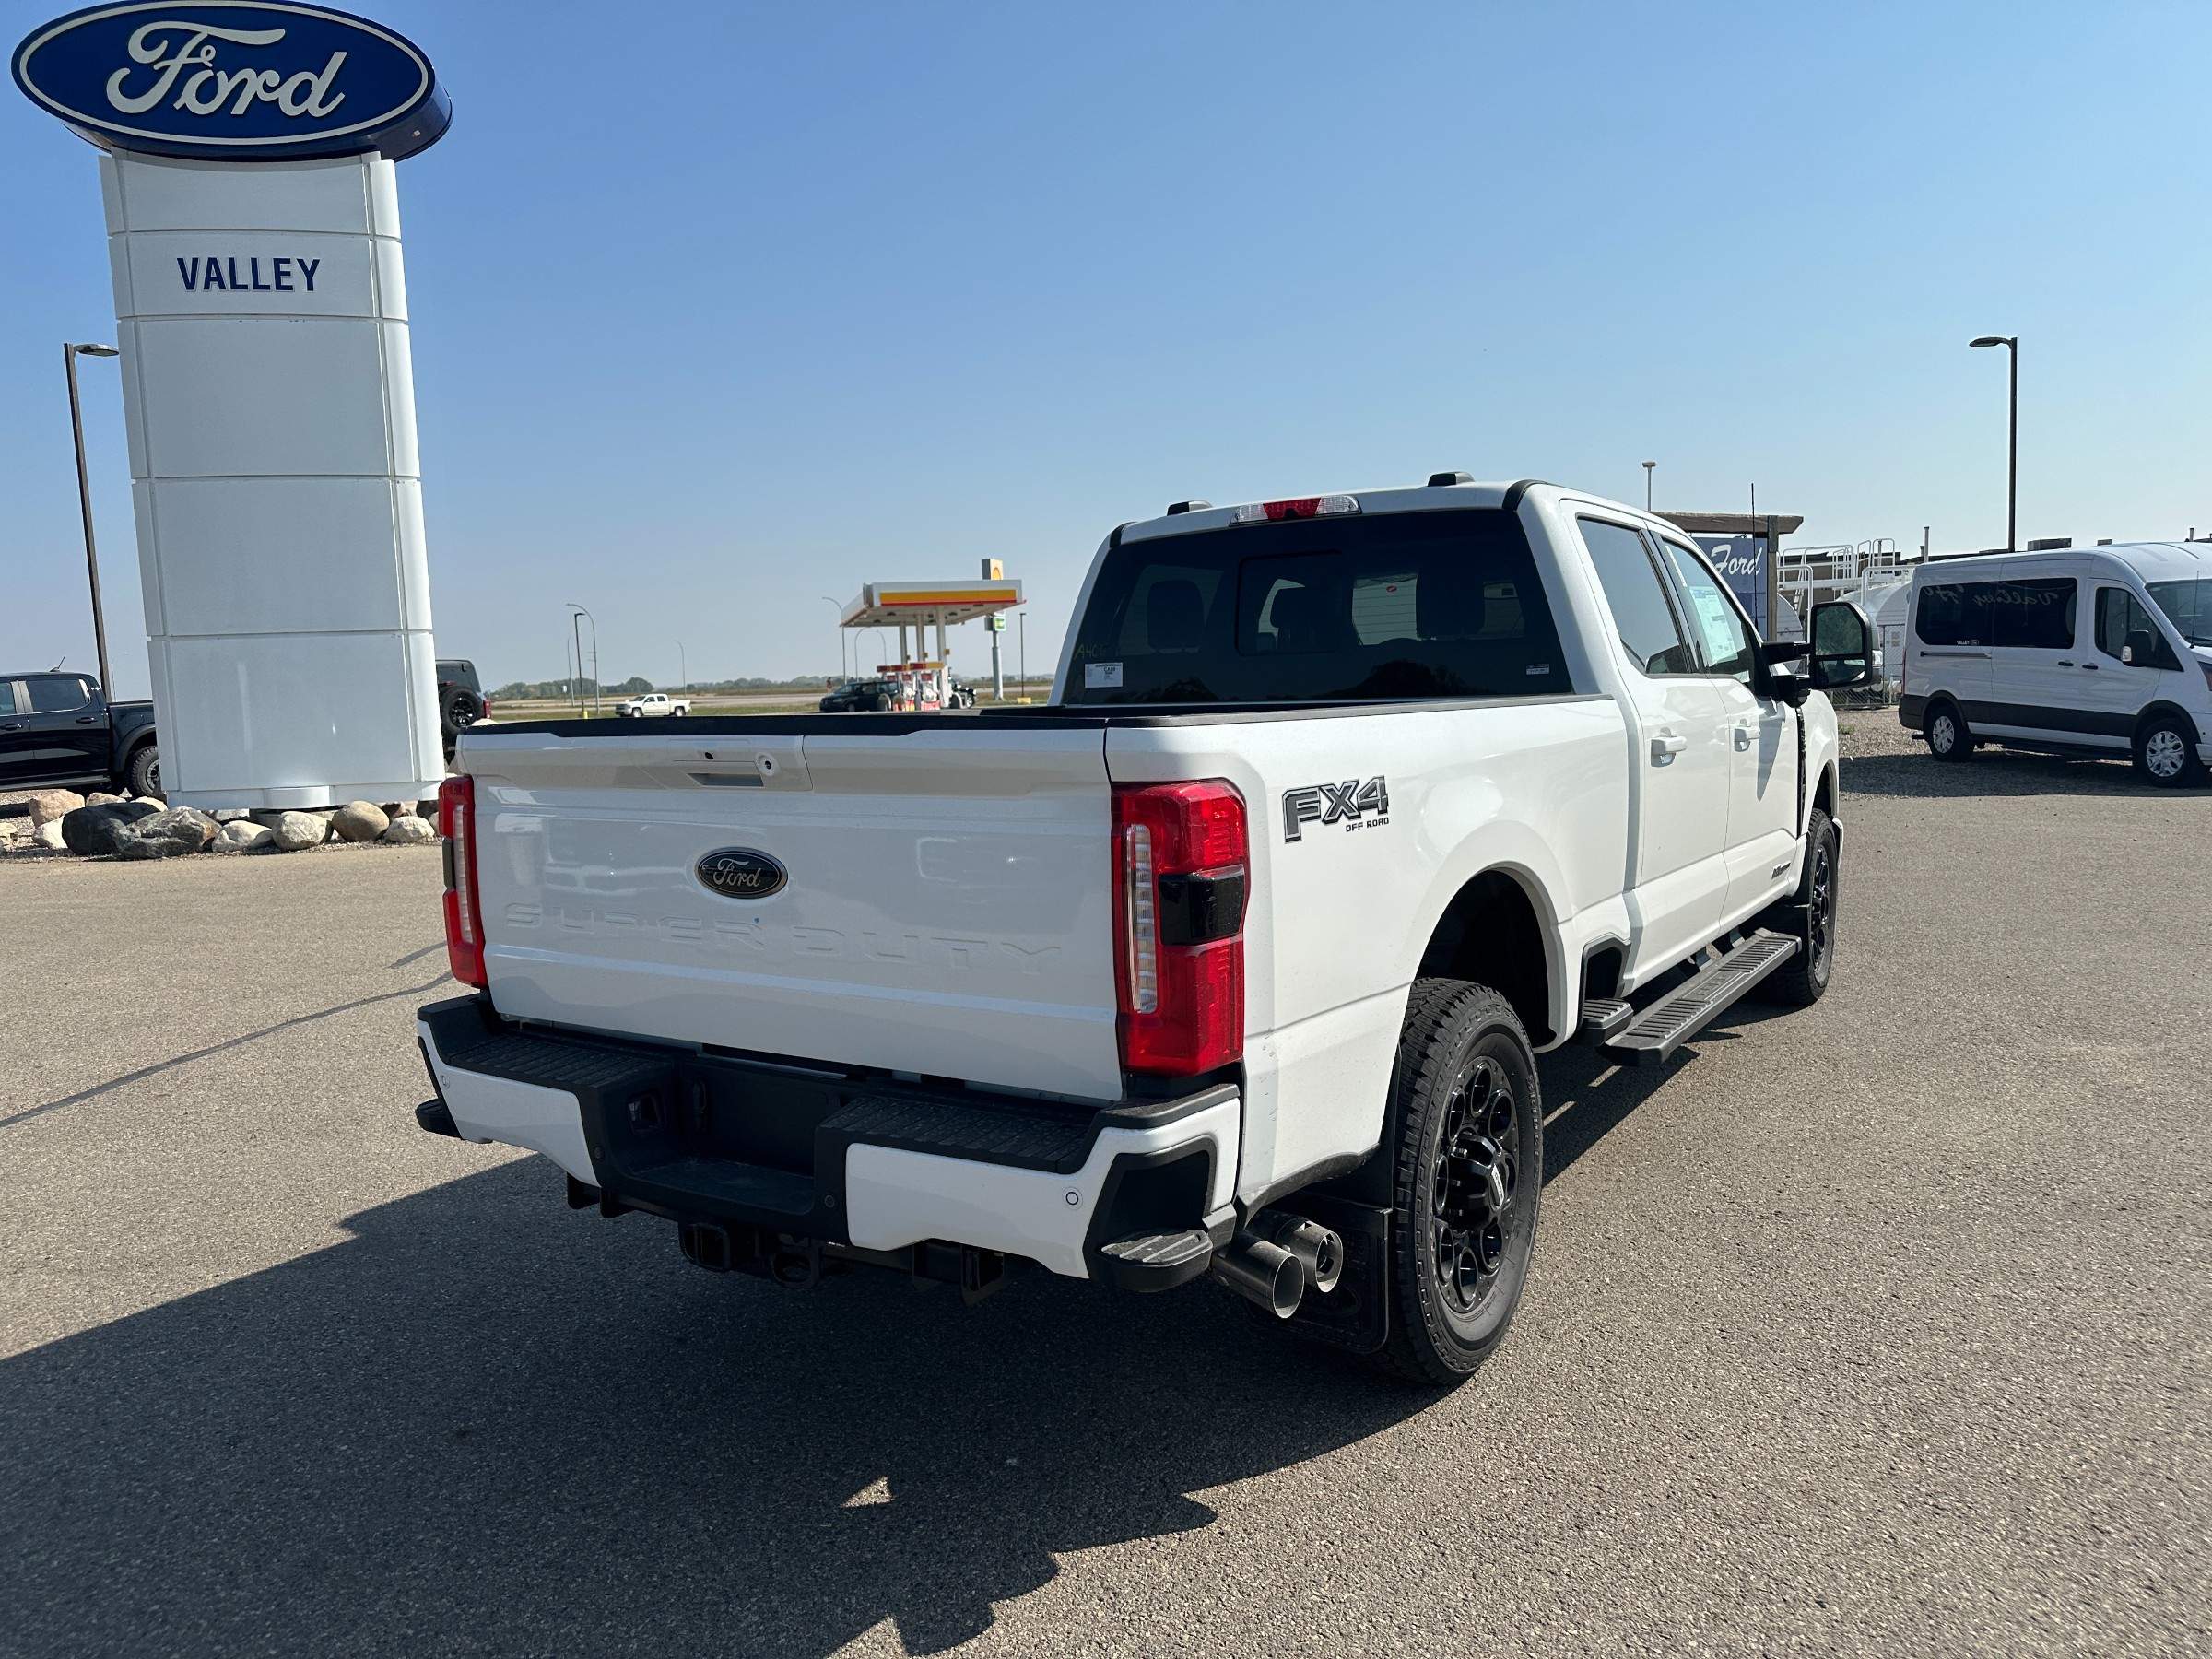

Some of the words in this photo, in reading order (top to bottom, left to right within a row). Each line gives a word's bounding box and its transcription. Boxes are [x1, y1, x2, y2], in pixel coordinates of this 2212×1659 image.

[106, 21, 348, 118] Ford
[177, 256, 321, 292] VALLEY
[1711, 543, 1763, 576] Ford
[1281, 774, 1389, 844] FX4
[1345, 821, 1364, 832] OFF
[1366, 817, 1390, 829] ROAD
[712, 857, 761, 888] Ford
[505, 901, 765, 951] SUPER
[791, 924, 1063, 975] DUTY
